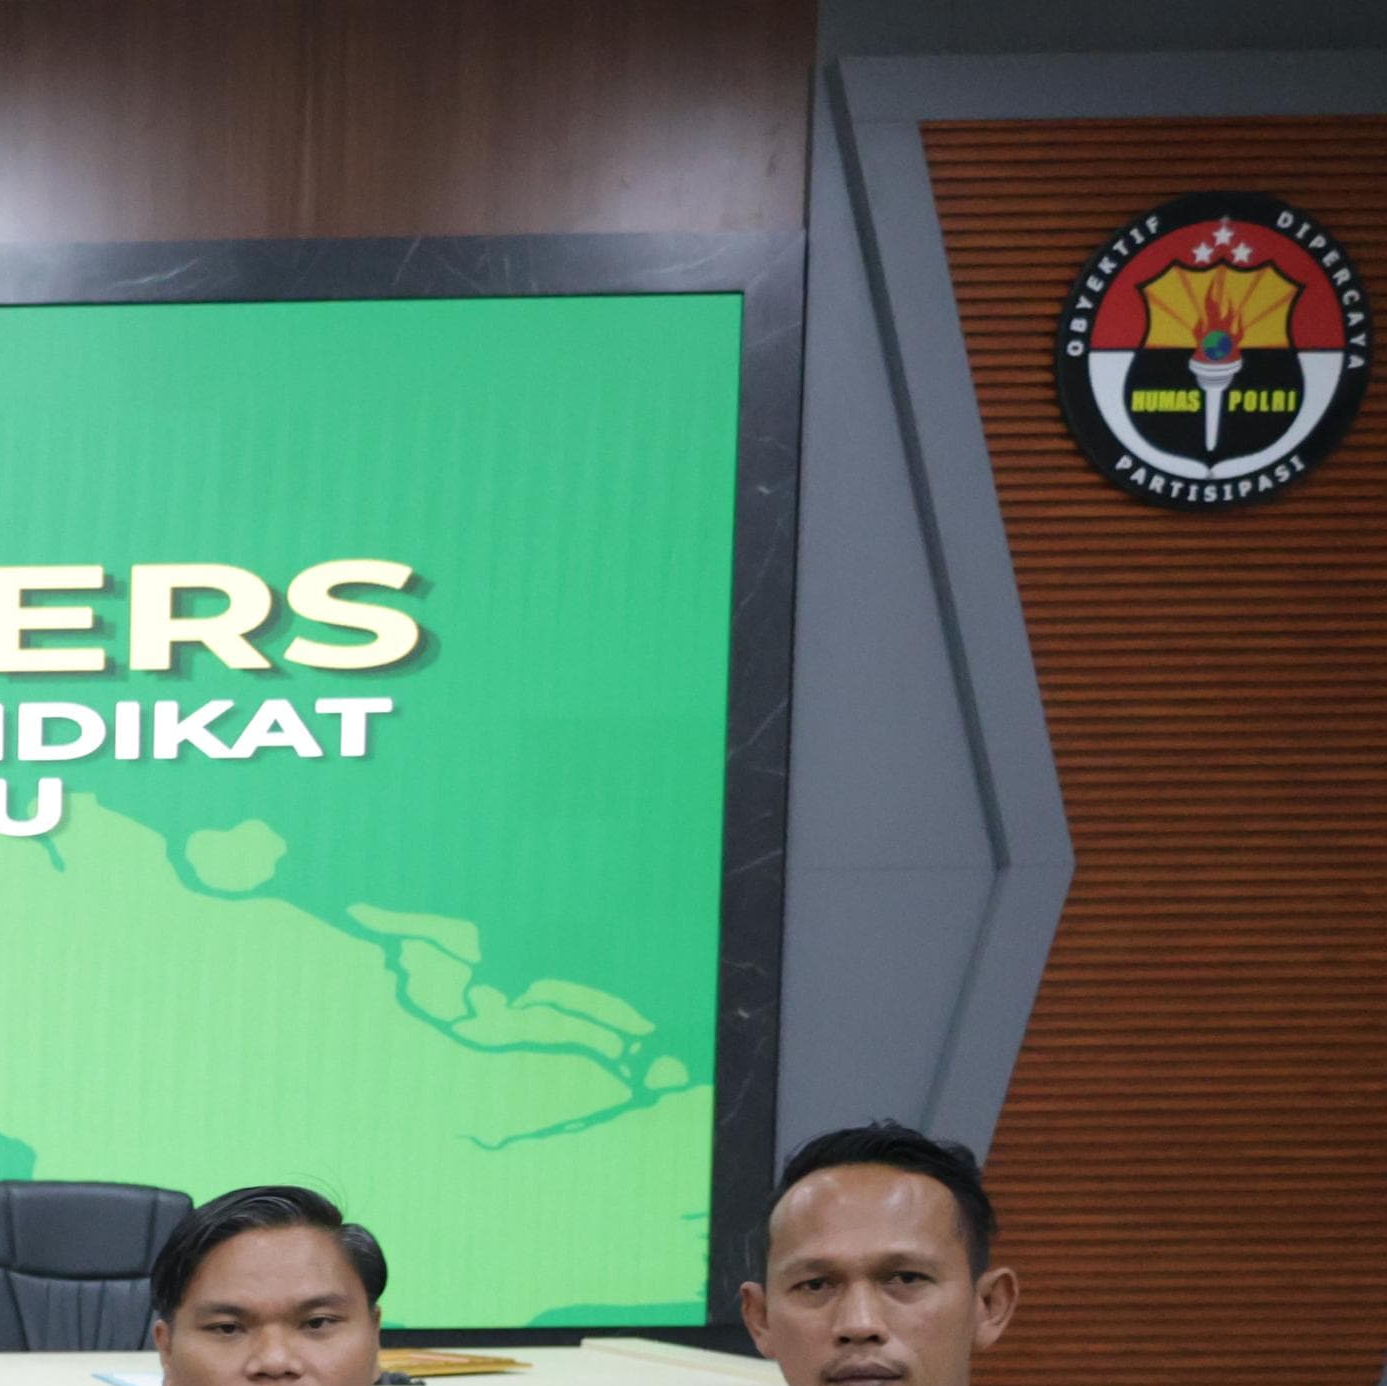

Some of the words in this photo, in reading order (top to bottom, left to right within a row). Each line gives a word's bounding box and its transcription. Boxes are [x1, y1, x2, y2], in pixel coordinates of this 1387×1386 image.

[1066, 214, 1162, 358] OBYEKTIF
[1276, 210, 1367, 370] DIPERCAYA
[1131, 390, 1202, 412] HUMAS
[1228, 390, 1297, 412] POLRI
[1115, 454, 1306, 502] PARTISIPASI
